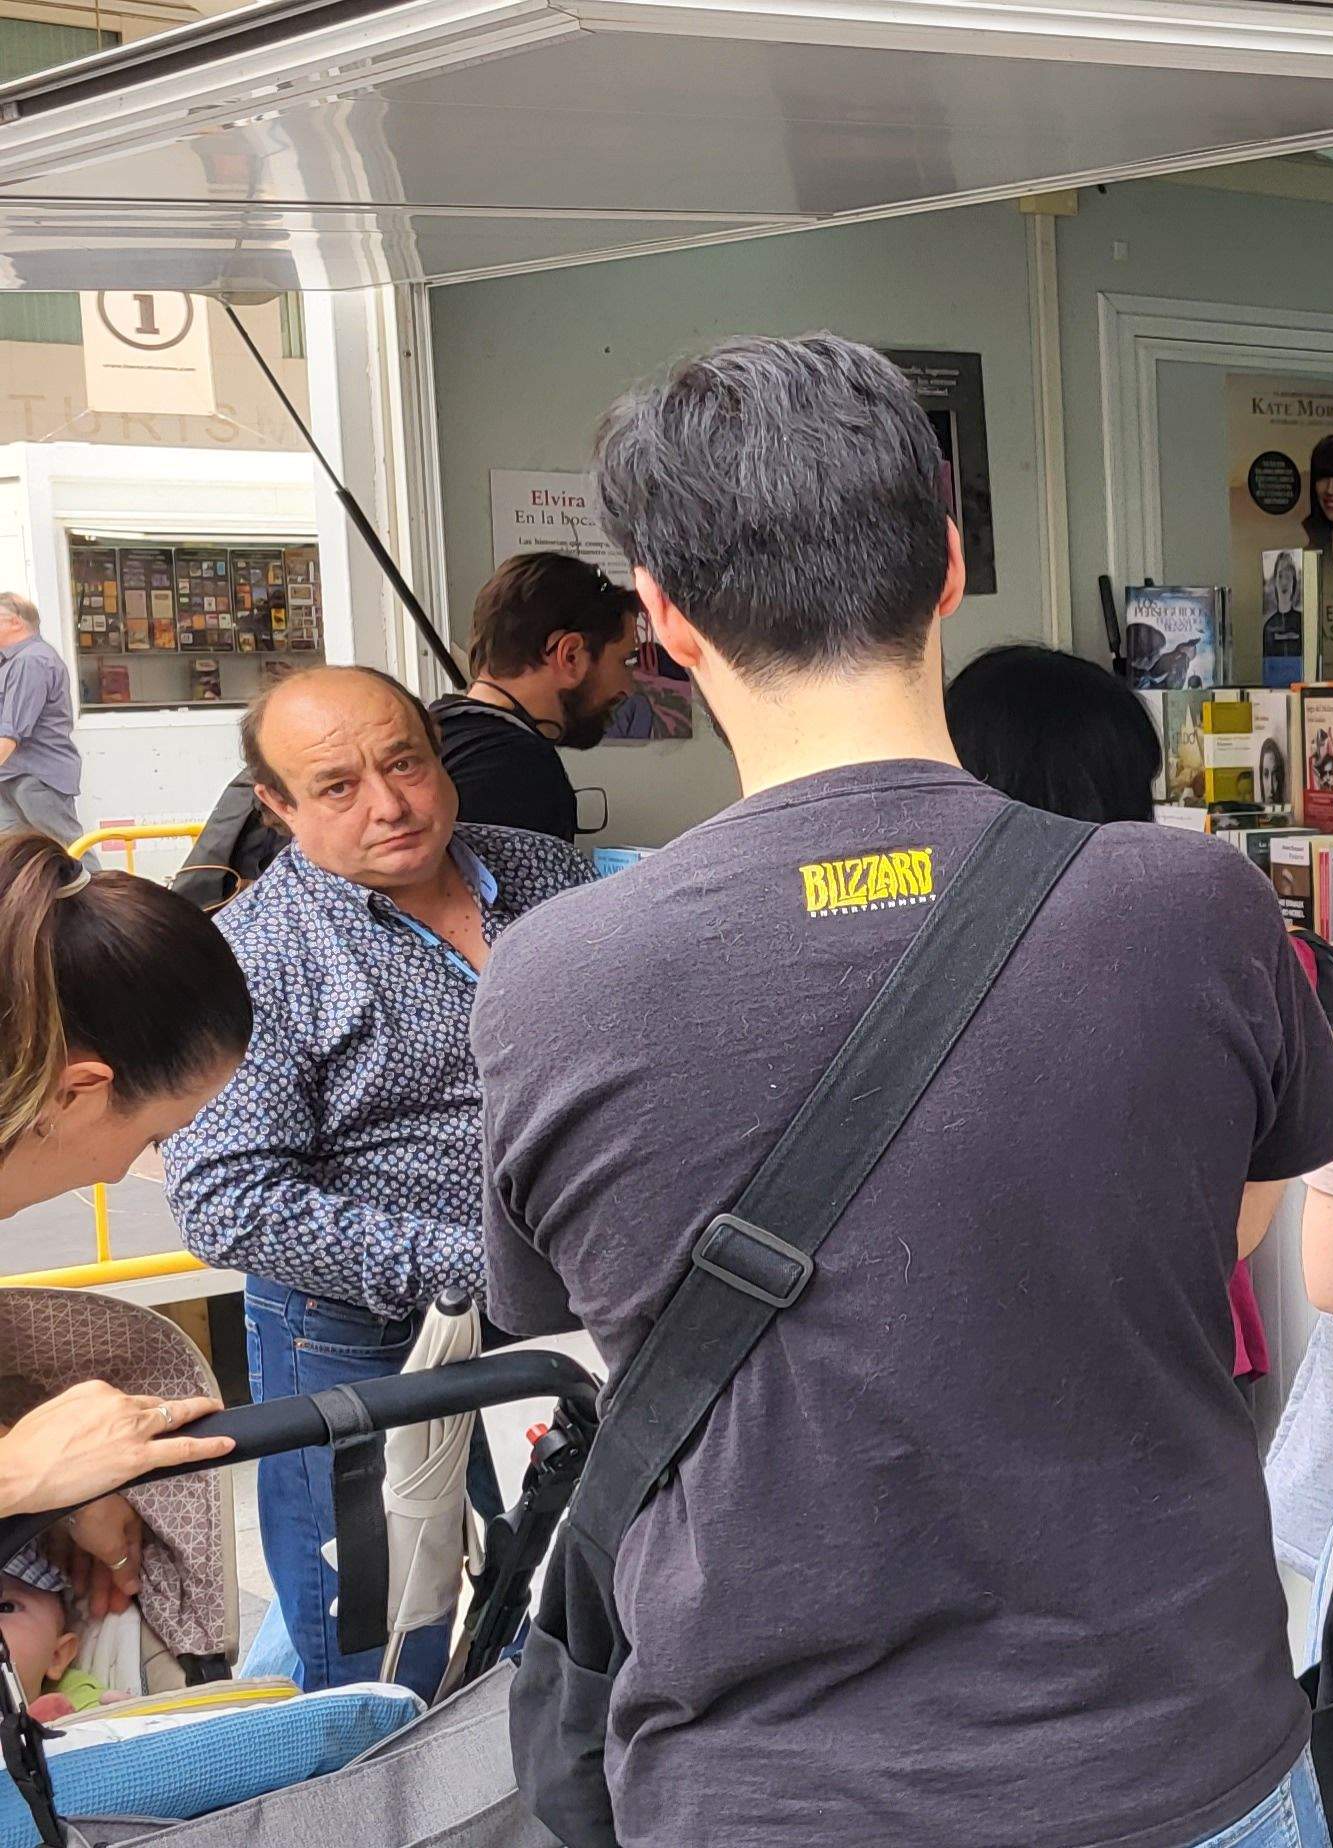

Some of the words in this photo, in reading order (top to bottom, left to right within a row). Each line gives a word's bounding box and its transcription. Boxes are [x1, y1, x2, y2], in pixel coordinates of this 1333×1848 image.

[531, 490, 586, 508] Elvira
[515, 510, 535, 525] En
[541, 510, 554, 525] la
[799, 847, 933, 912] BLIZZARD
[810, 894, 937, 919] ENTERTAINMENT
